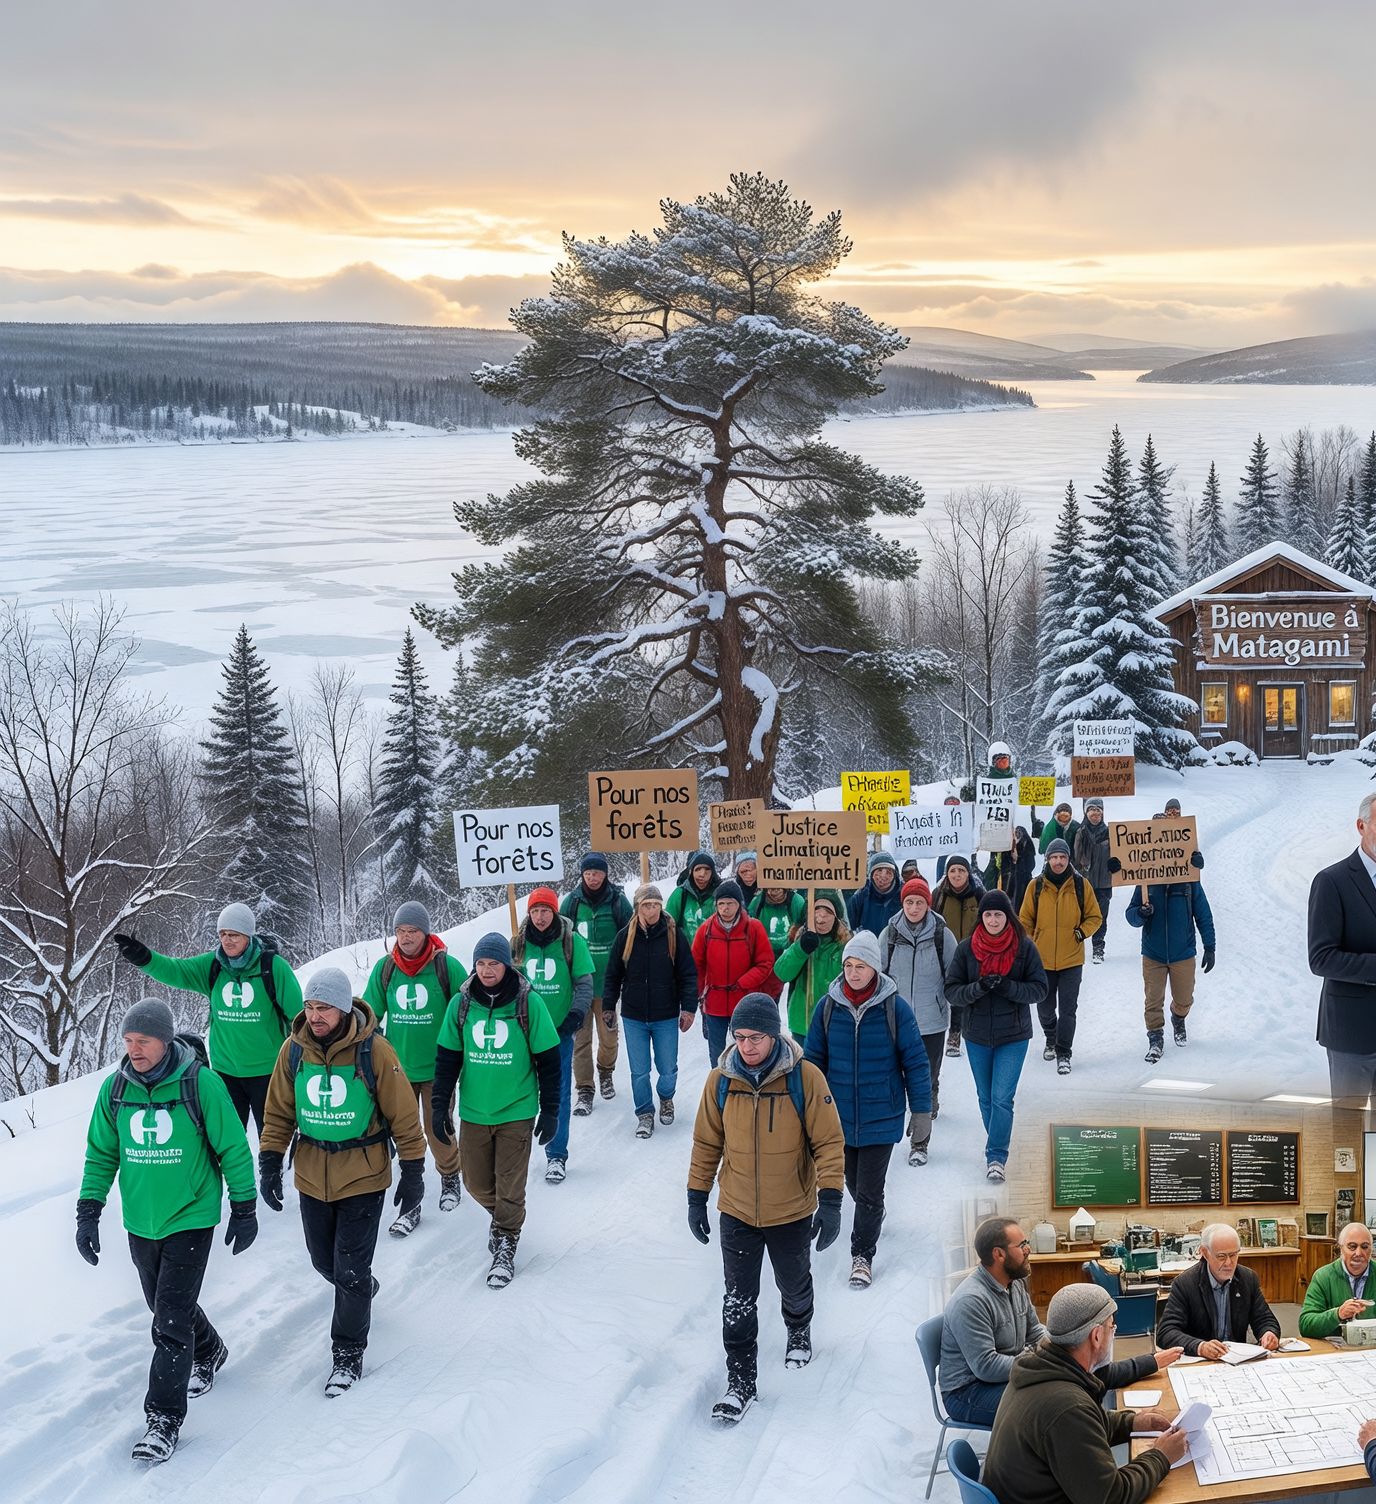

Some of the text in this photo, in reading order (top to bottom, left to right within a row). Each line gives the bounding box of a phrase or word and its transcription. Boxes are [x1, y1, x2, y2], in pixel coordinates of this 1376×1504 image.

[1210, 603, 1359, 629] Bienvenue à
[1211, 633, 1350, 666] Matagami
[596, 776, 690, 806] Pour nos
[460, 813, 554, 843] Pour nos
[606, 809, 683, 840] forêts
[772, 813, 838, 836] Justice
[471, 844, 554, 876] forêts
[762, 836, 851, 864] climatique
